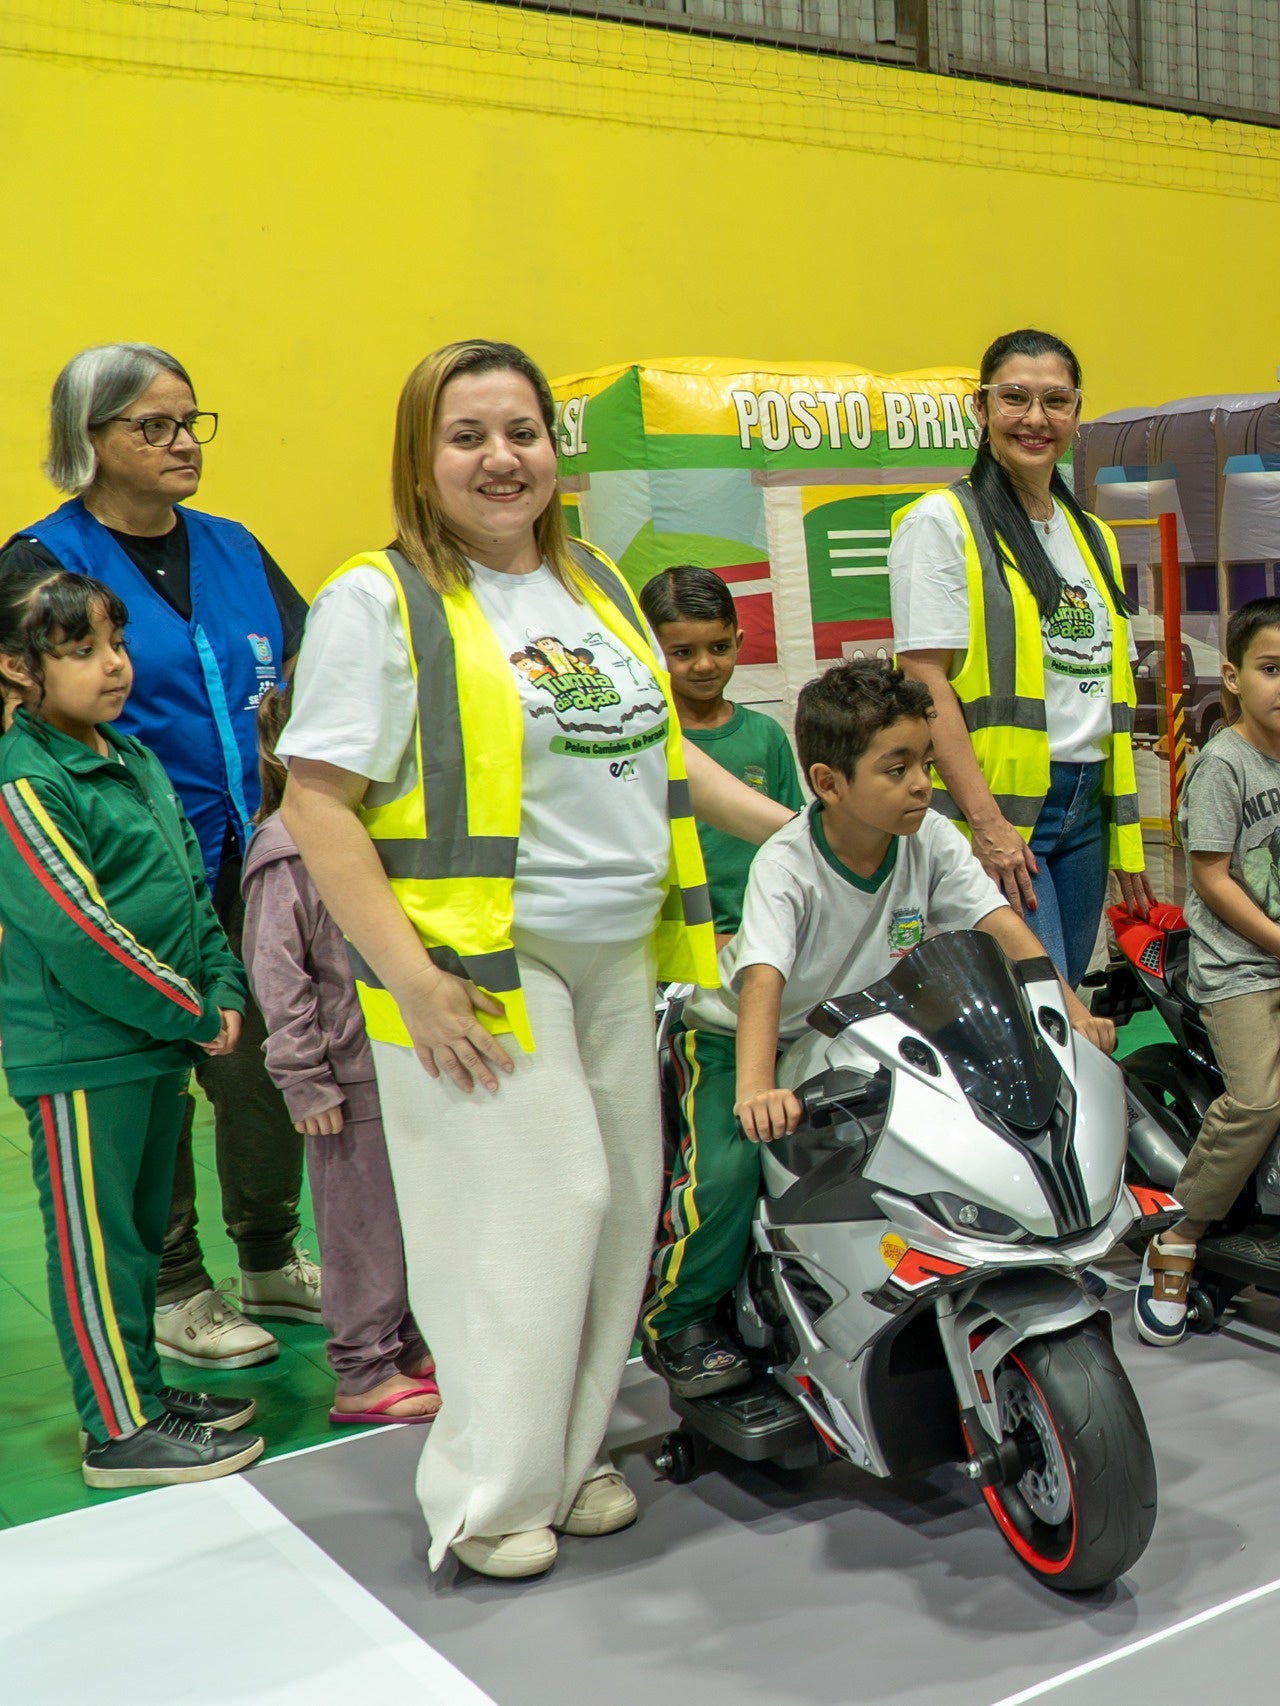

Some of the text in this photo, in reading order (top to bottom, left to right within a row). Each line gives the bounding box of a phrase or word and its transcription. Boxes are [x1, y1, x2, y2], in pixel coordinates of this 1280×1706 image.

[731, 390, 872, 451] POSTO
[1048, 620, 1095, 642] da ação
[1051, 660, 1068, 672] Pelos
[1069, 665, 1099, 674] Caminhos
[532, 672, 615, 697] Turma
[554, 688, 621, 713] da ação
[565, 726, 666, 754] Pelos Caminhos do Paraná
